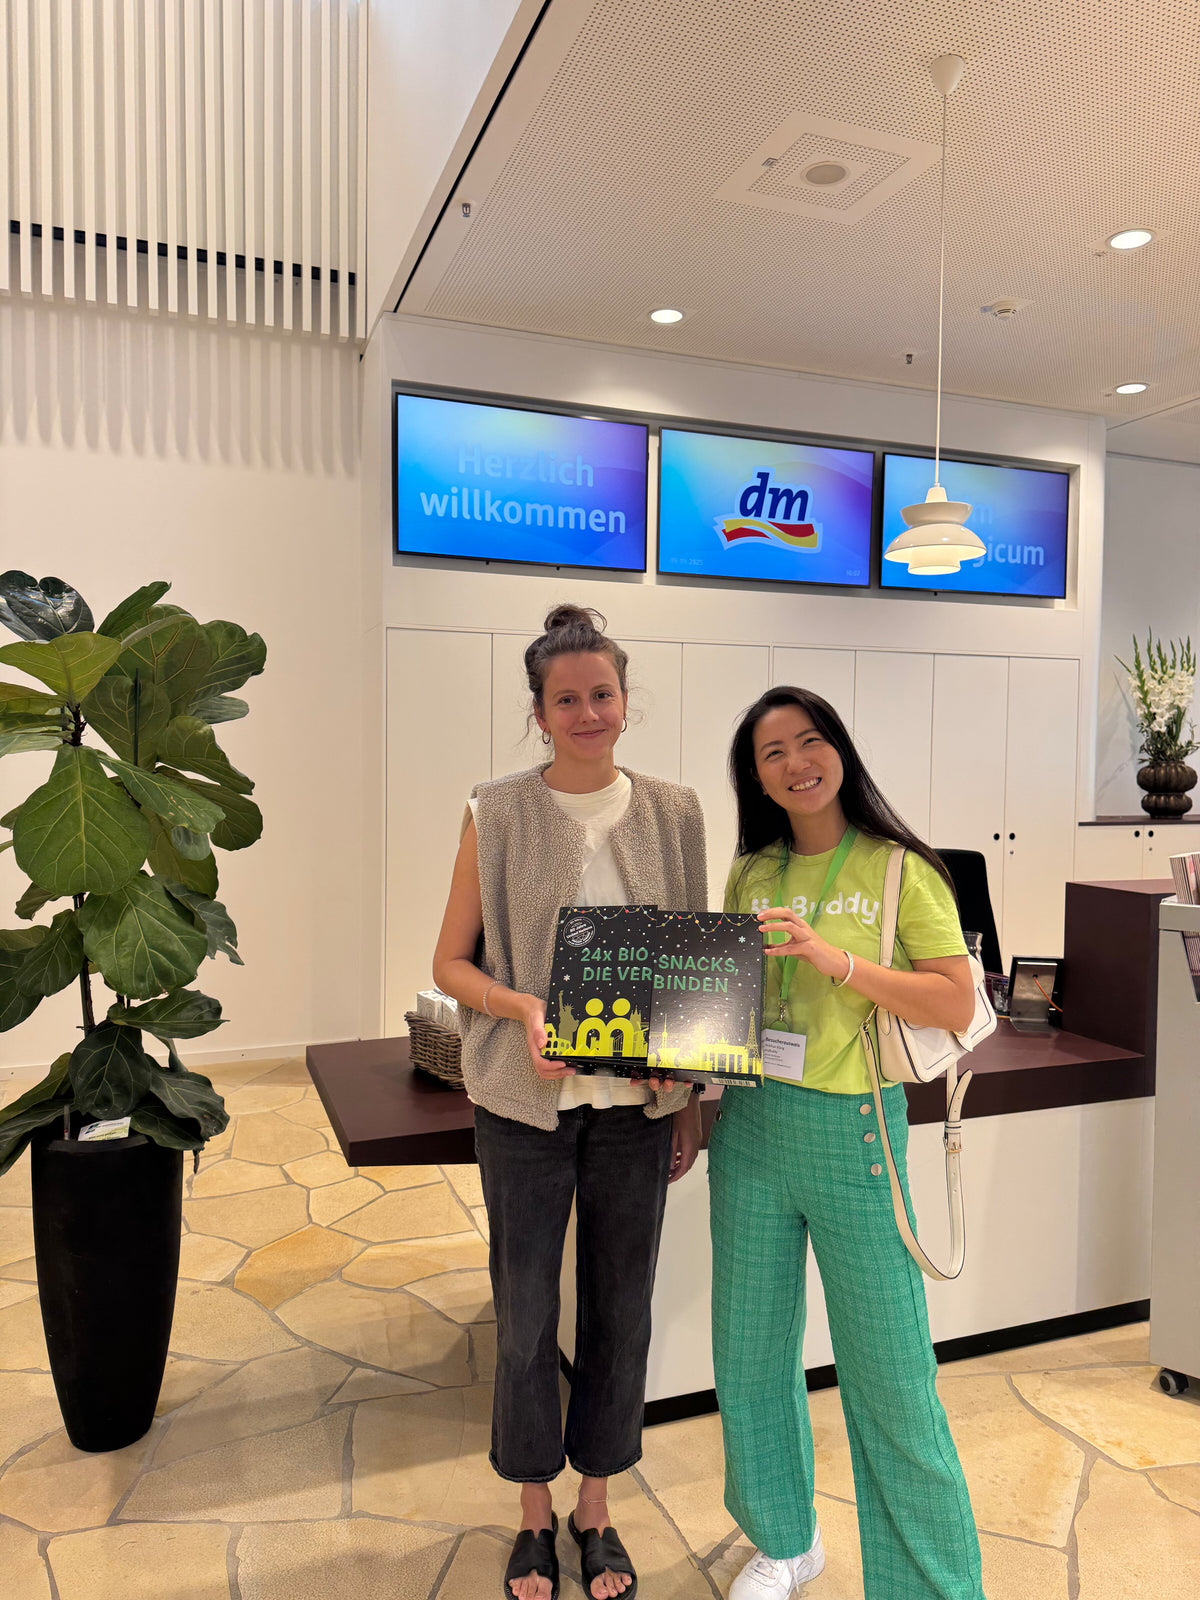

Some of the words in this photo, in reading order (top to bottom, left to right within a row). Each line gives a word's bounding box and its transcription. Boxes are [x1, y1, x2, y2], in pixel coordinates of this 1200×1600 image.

[457, 444, 595, 488] Herzlich
[419, 486, 626, 534] willkommen
[739, 471, 809, 522] dm
[580, 947, 613, 962] 24x
[582, 966, 613, 981] DIE
